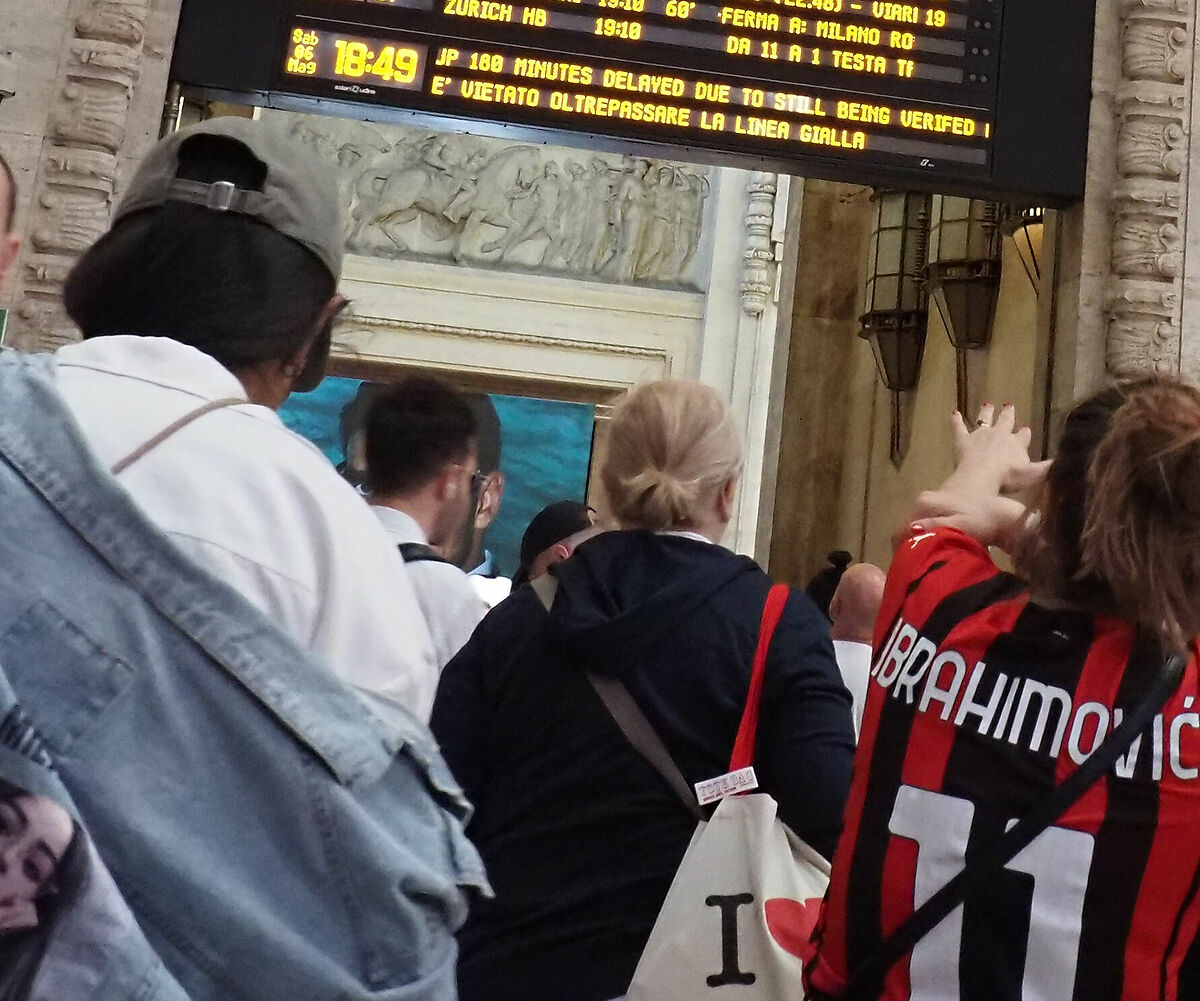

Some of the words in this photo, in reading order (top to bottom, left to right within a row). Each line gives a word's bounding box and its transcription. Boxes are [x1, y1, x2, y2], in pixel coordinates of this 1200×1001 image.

[521, 6, 547, 27] HB
[594, 17, 641, 40] 19:10
[725, 35, 751, 55] DA
[760, 40, 778, 59] 11
[787, 43, 802, 62] A
[810, 47, 820, 65] 1
[831, 49, 886, 74] TESTA
[664, 0, 696, 19] 60'
[788, 16, 807, 34] A:
[815, 20, 880, 45] MILANO
[924, 8, 946, 27] 19
[335, 40, 419, 84] 18:49
[468, 51, 504, 73] 180
[512, 57, 593, 85] MINUTES
[602, 68, 685, 97] DELAYED
[694, 81, 731, 103] DUE
[741, 87, 764, 108] TO
[773, 91, 826, 116] STILL
[836, 100, 890, 124] BEING
[899, 109, 975, 136] VERIFED
[430, 75, 452, 95] E'
[460, 79, 540, 107] VIETATO
[548, 90, 691, 127] OLTREPASSARE
[699, 110, 725, 131] LA
[734, 115, 790, 139] LINEA
[798, 123, 865, 150] GIALLA
[888, 784, 1095, 1001] 11
[705, 893, 756, 988] I
